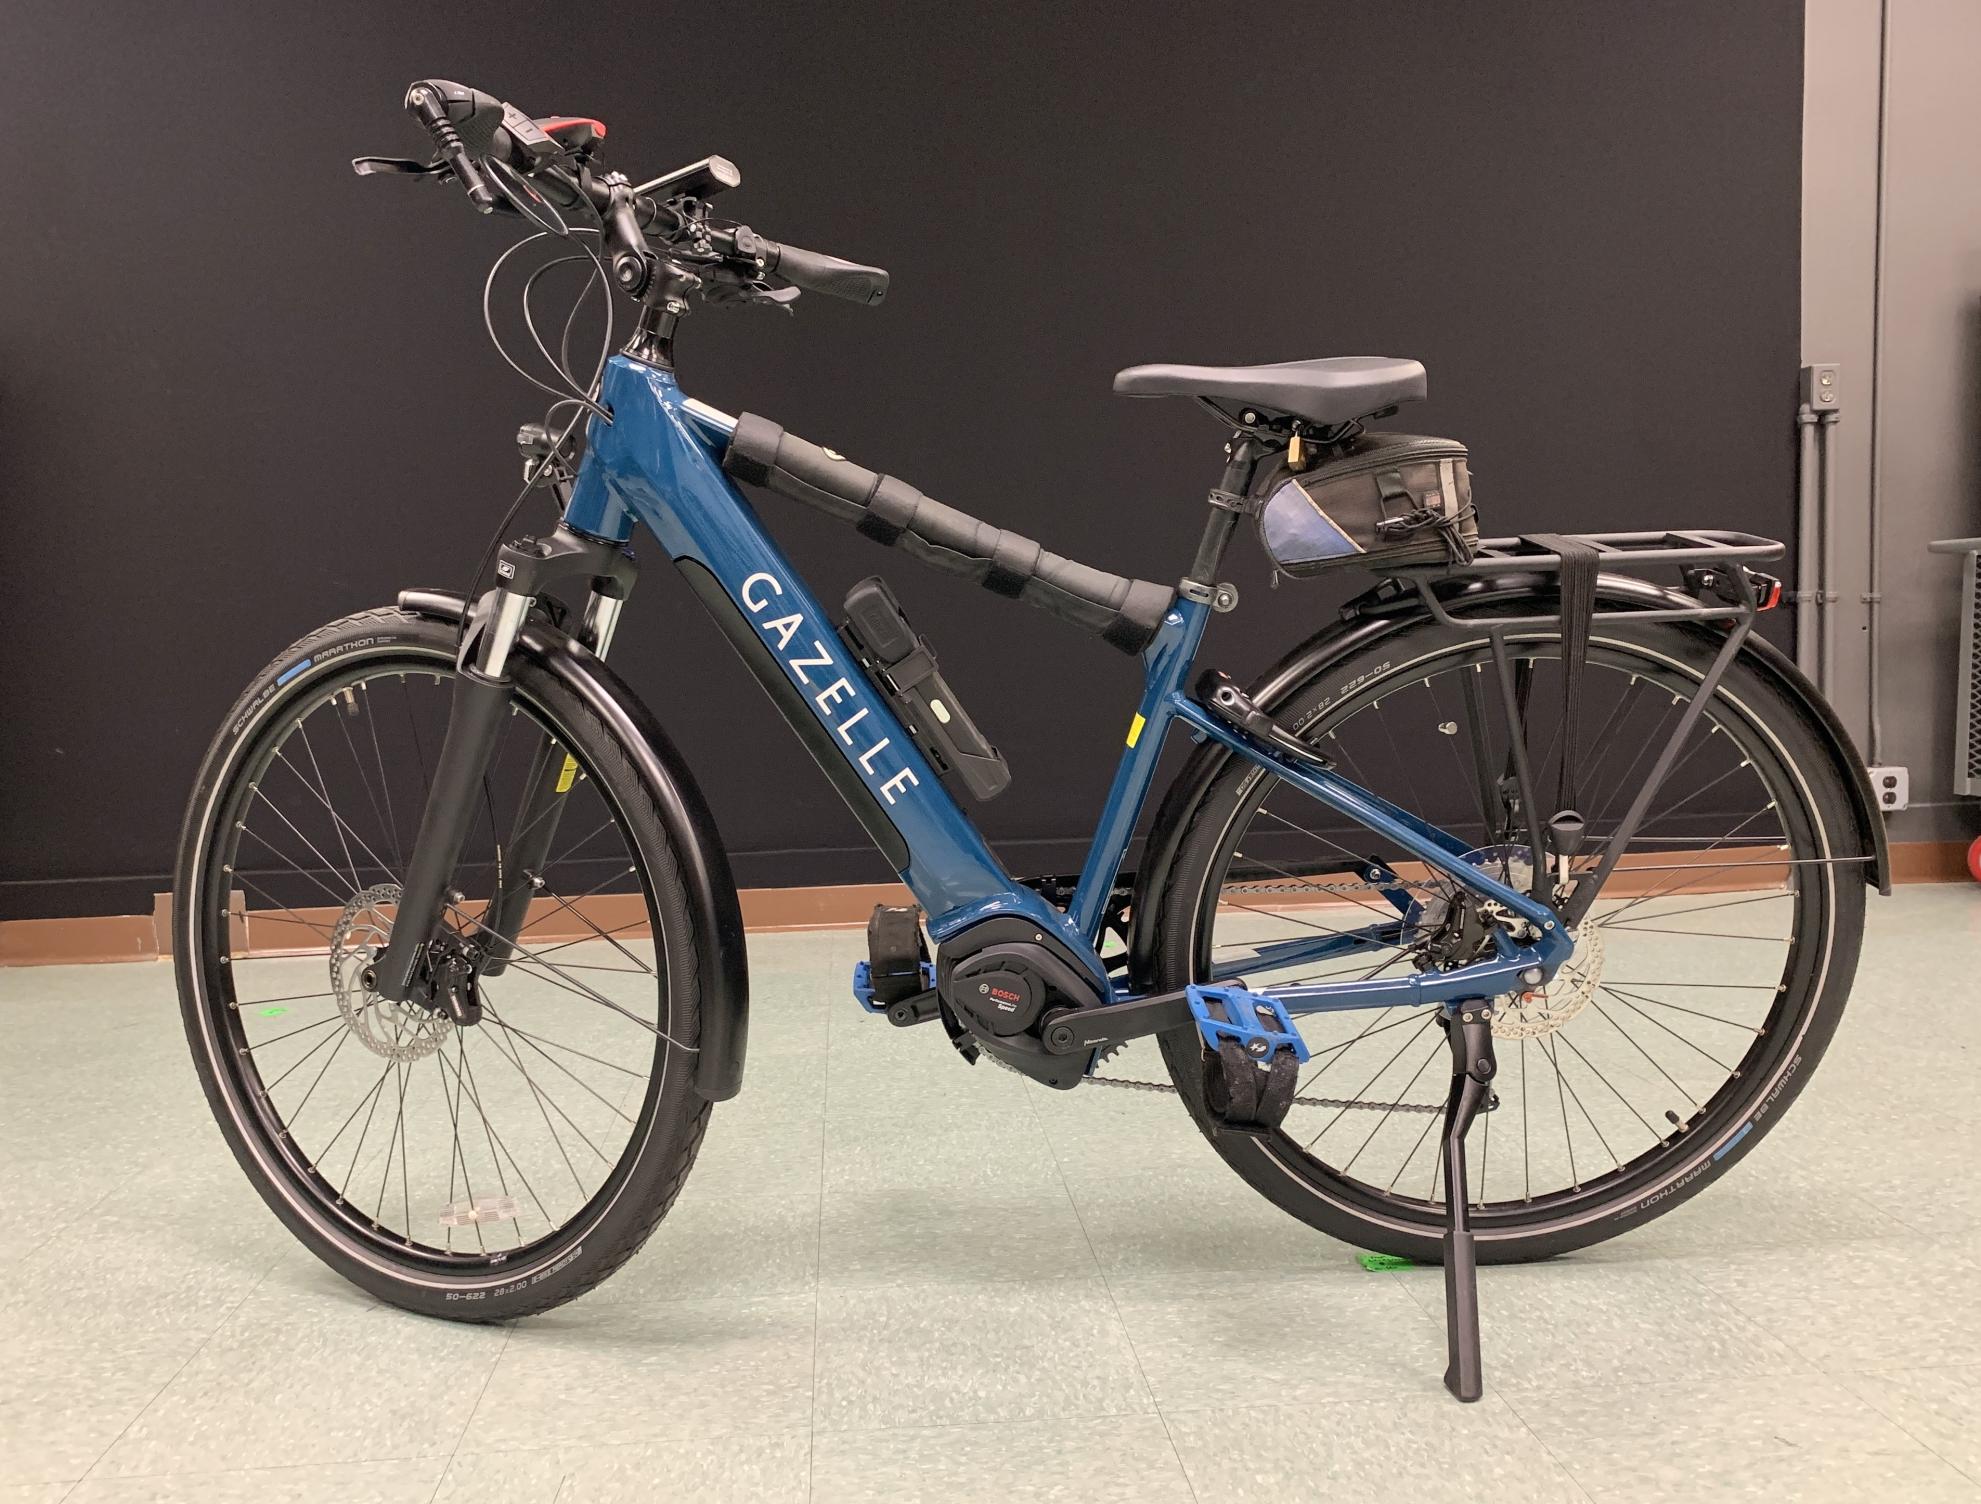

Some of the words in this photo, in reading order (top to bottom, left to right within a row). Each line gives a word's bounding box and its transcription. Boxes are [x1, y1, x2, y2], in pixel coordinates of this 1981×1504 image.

[232, 683, 276, 736] SCHWALBE
[313, 637, 375, 663] MARATHON
[740, 571, 920, 806] GAZELLE
[1340, 660, 1391, 695] 50-622
[991, 987, 1021, 1002] BOSCH
[997, 1003, 1016, 1013] Speed
[1753, 1054, 1802, 1122] SCHWALBE
[1640, 1159, 1712, 1209] MARATHON
[445, 1291, 486, 1301] 50-622
